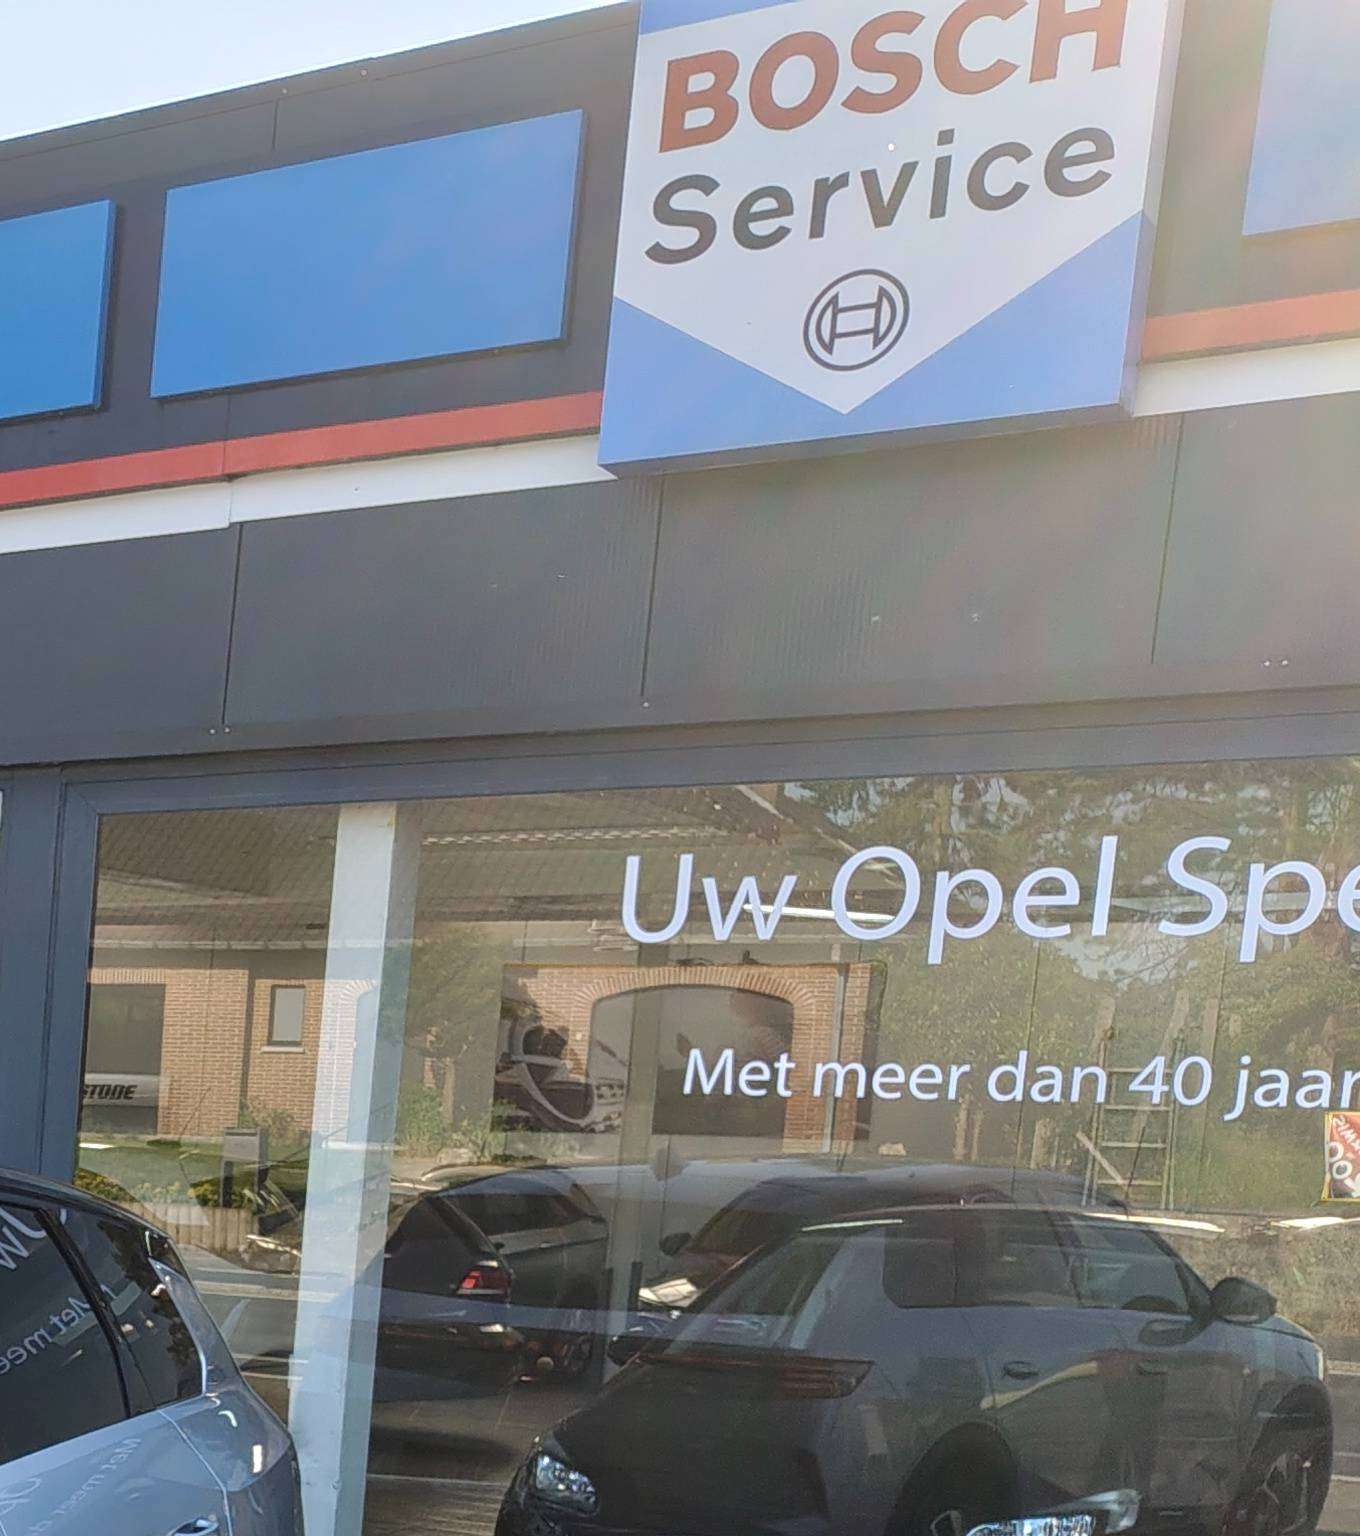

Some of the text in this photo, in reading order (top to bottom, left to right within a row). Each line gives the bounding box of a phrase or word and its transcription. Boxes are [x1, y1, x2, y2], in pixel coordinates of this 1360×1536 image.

[659, 0, 1128, 153] BOSCH
[644, 127, 1116, 265] Service
[622, 853, 798, 944] Uw
[830, 835, 1118, 965] Opel
[683, 1048, 1360, 1121] Met meer dan 40 jaar
